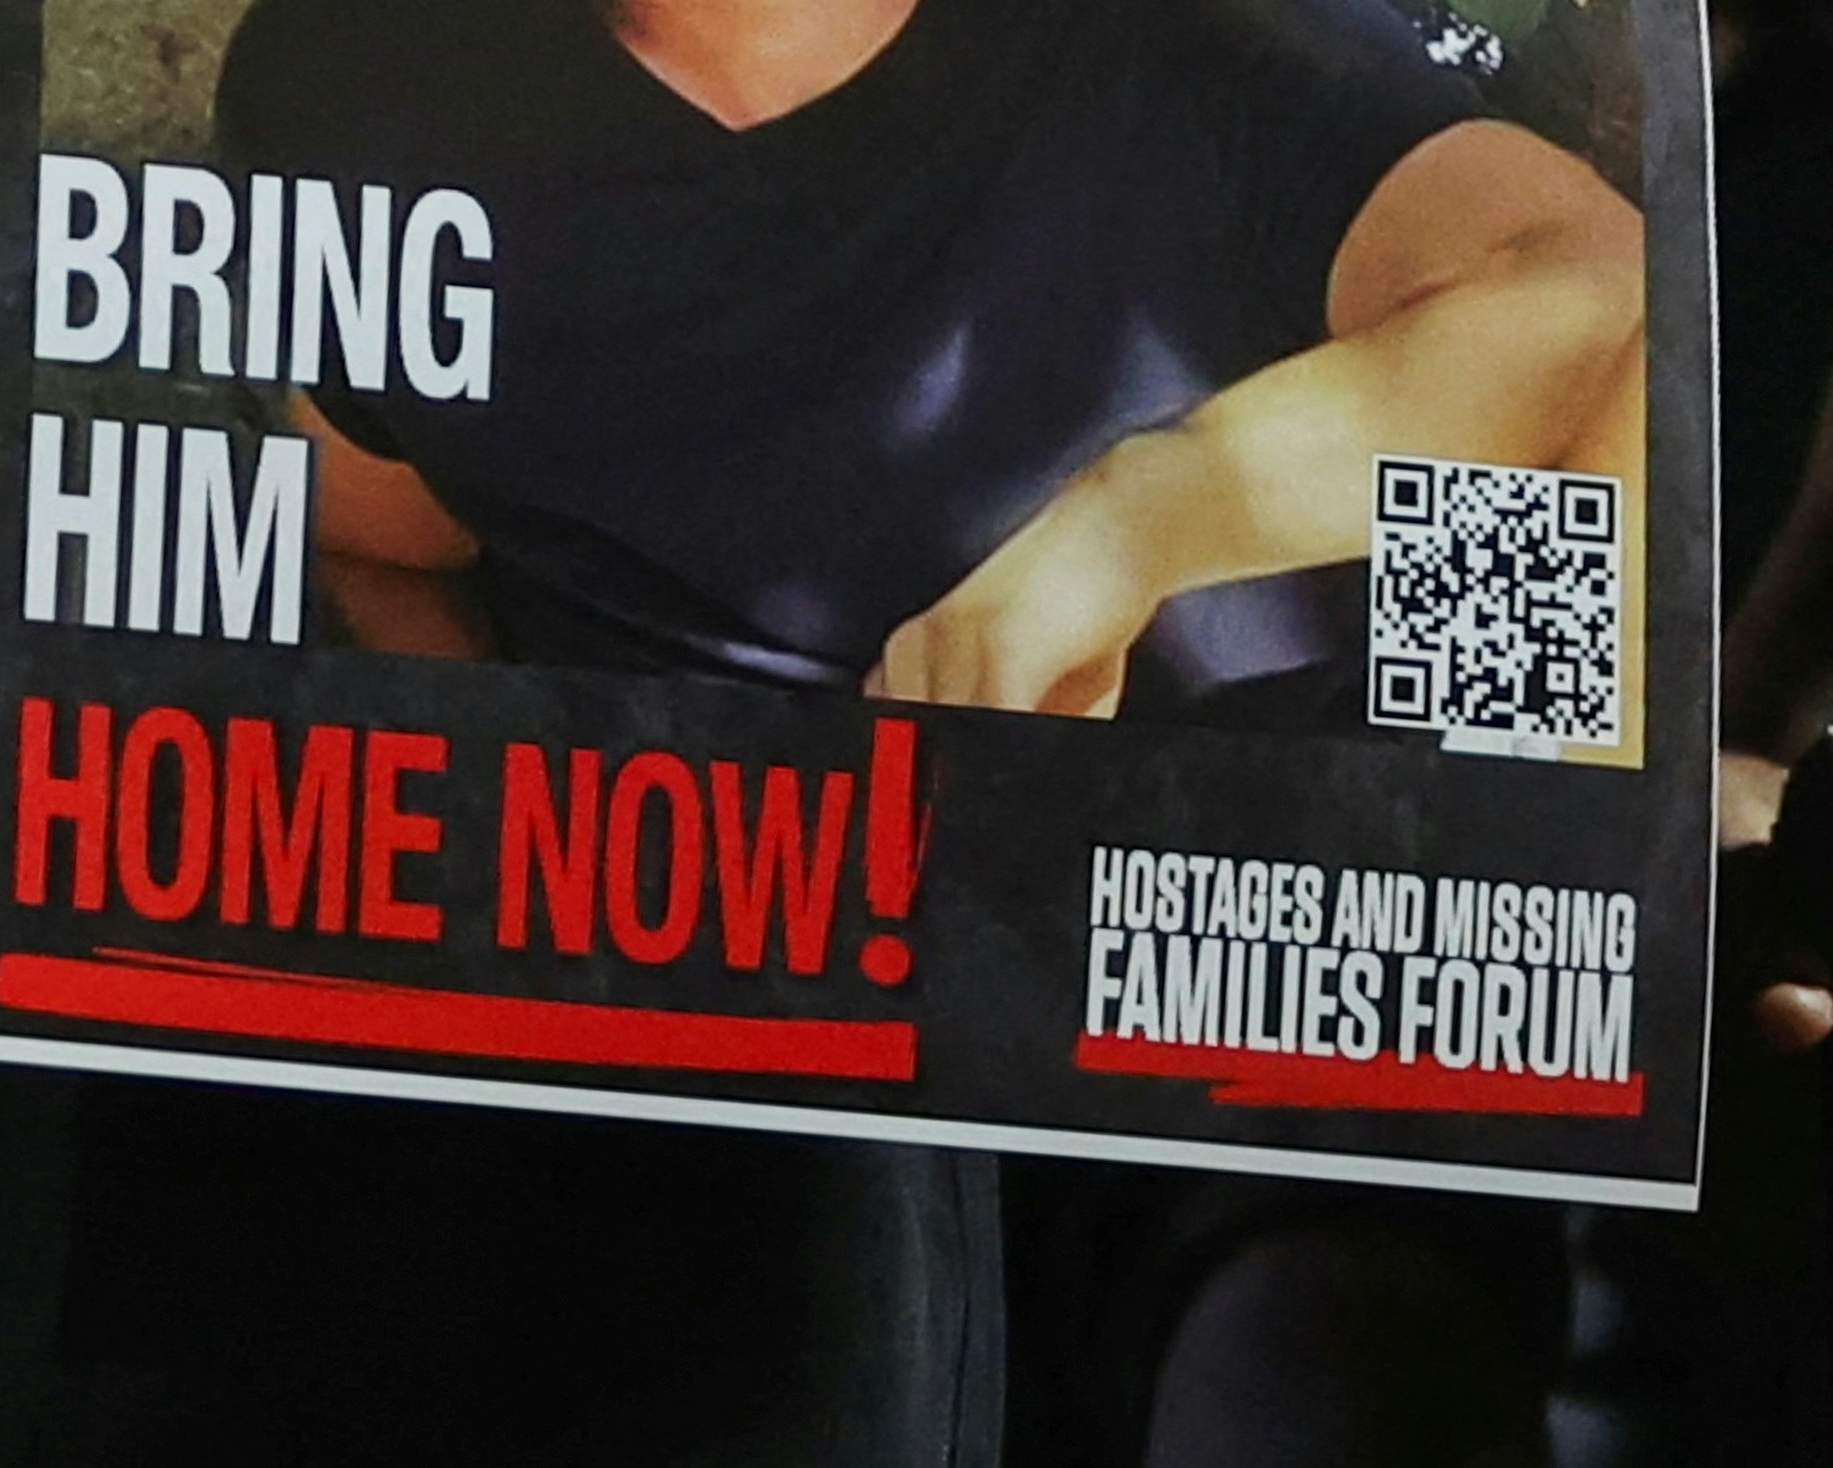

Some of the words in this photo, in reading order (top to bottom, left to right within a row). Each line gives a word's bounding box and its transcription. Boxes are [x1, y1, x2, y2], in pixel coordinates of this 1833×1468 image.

[34, 153, 494, 402] BRING
[23, 414, 309, 646] HIM
[13, 696, 451, 944] HOME
[497, 718, 928, 987] NOW!
[1090, 846, 1325, 945] HOSTAGES
[1332, 869, 1426, 955] AND
[1434, 878, 1636, 973] MISSING
[1086, 929, 1383, 1062] FAMILIES
[1399, 956, 1633, 1083] FORUM
